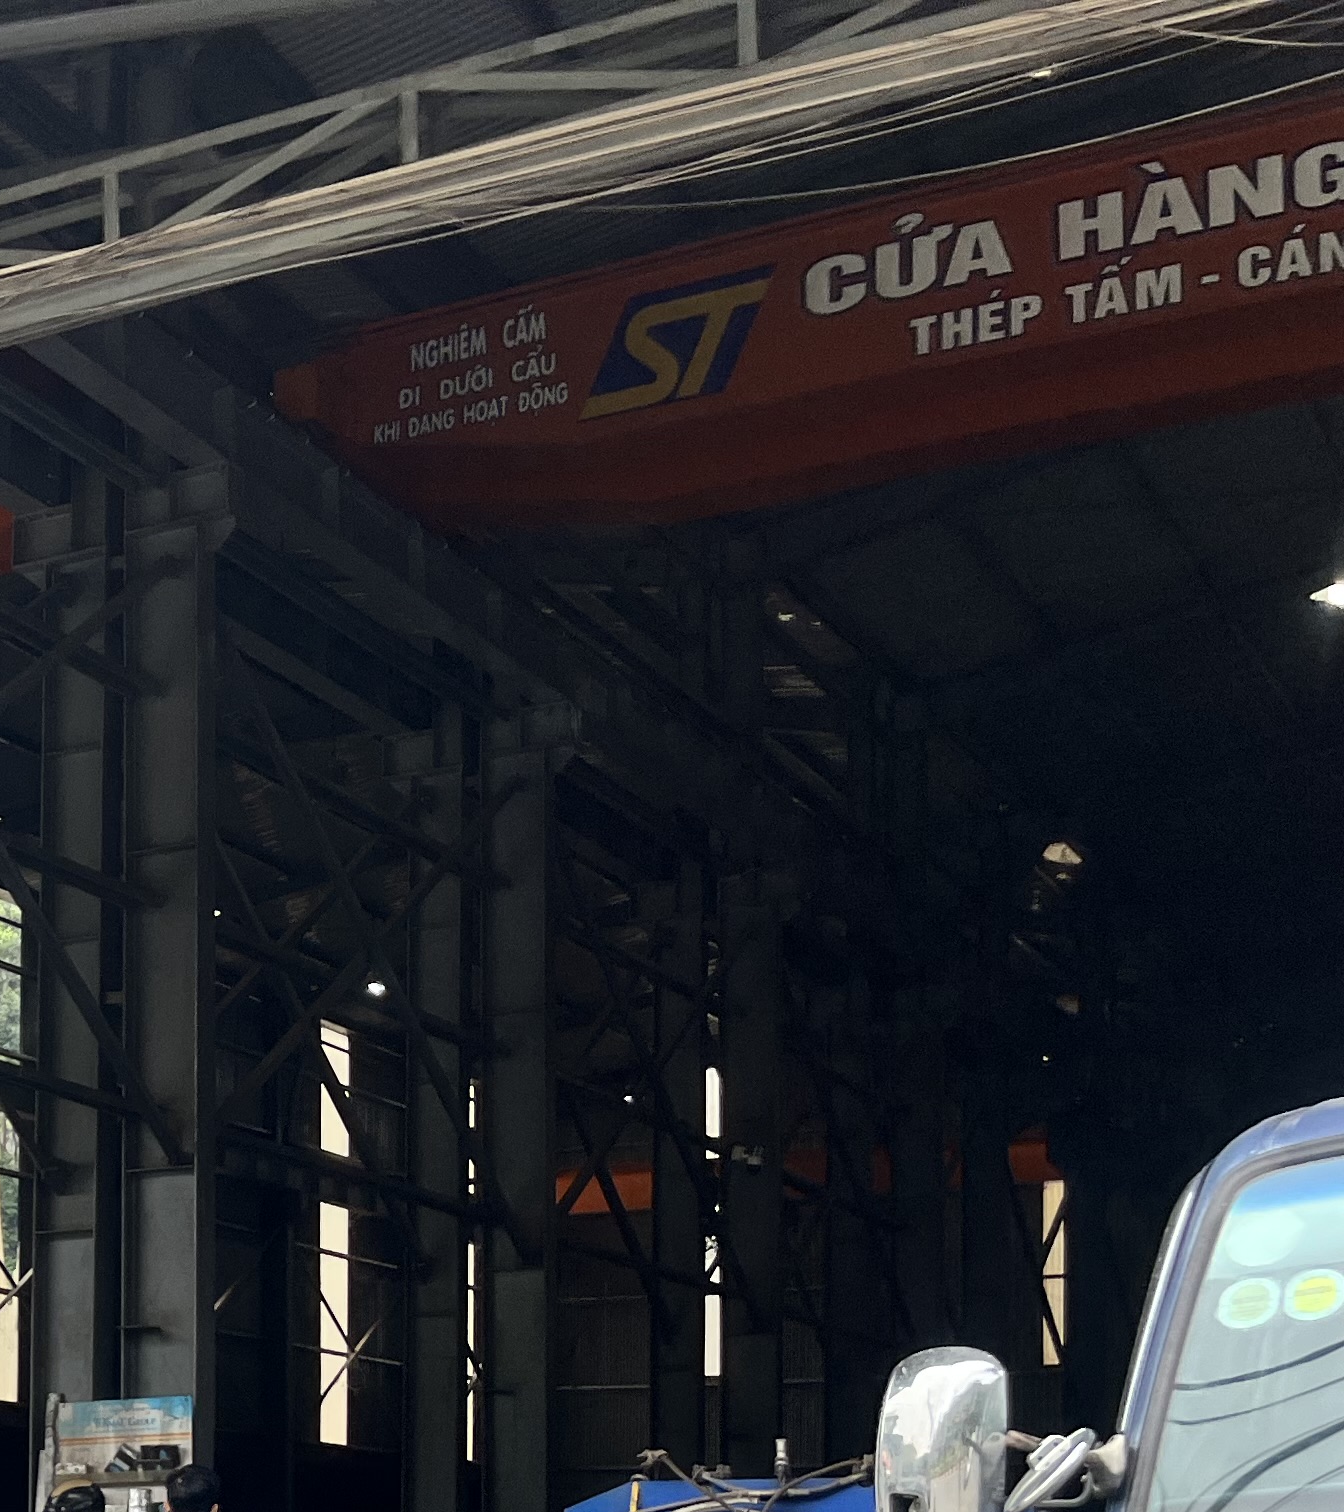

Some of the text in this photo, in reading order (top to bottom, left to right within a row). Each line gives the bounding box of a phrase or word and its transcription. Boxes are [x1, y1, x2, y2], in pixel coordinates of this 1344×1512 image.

[803, 142, 1344, 315] CỬA HÀNG
[410, 304, 547, 372] NGHIÊM CẤM
[911, 290, 1044, 355] THÉP
[1065, 255, 1184, 324] TẤM
[373, 423, 399, 444] KHI
[463, 396, 508, 427] HOẠT
[519, 382, 569, 417] ĐỘNG
[398, 386, 420, 410] ĐI
[439, 364, 494, 400] DƯỚI
